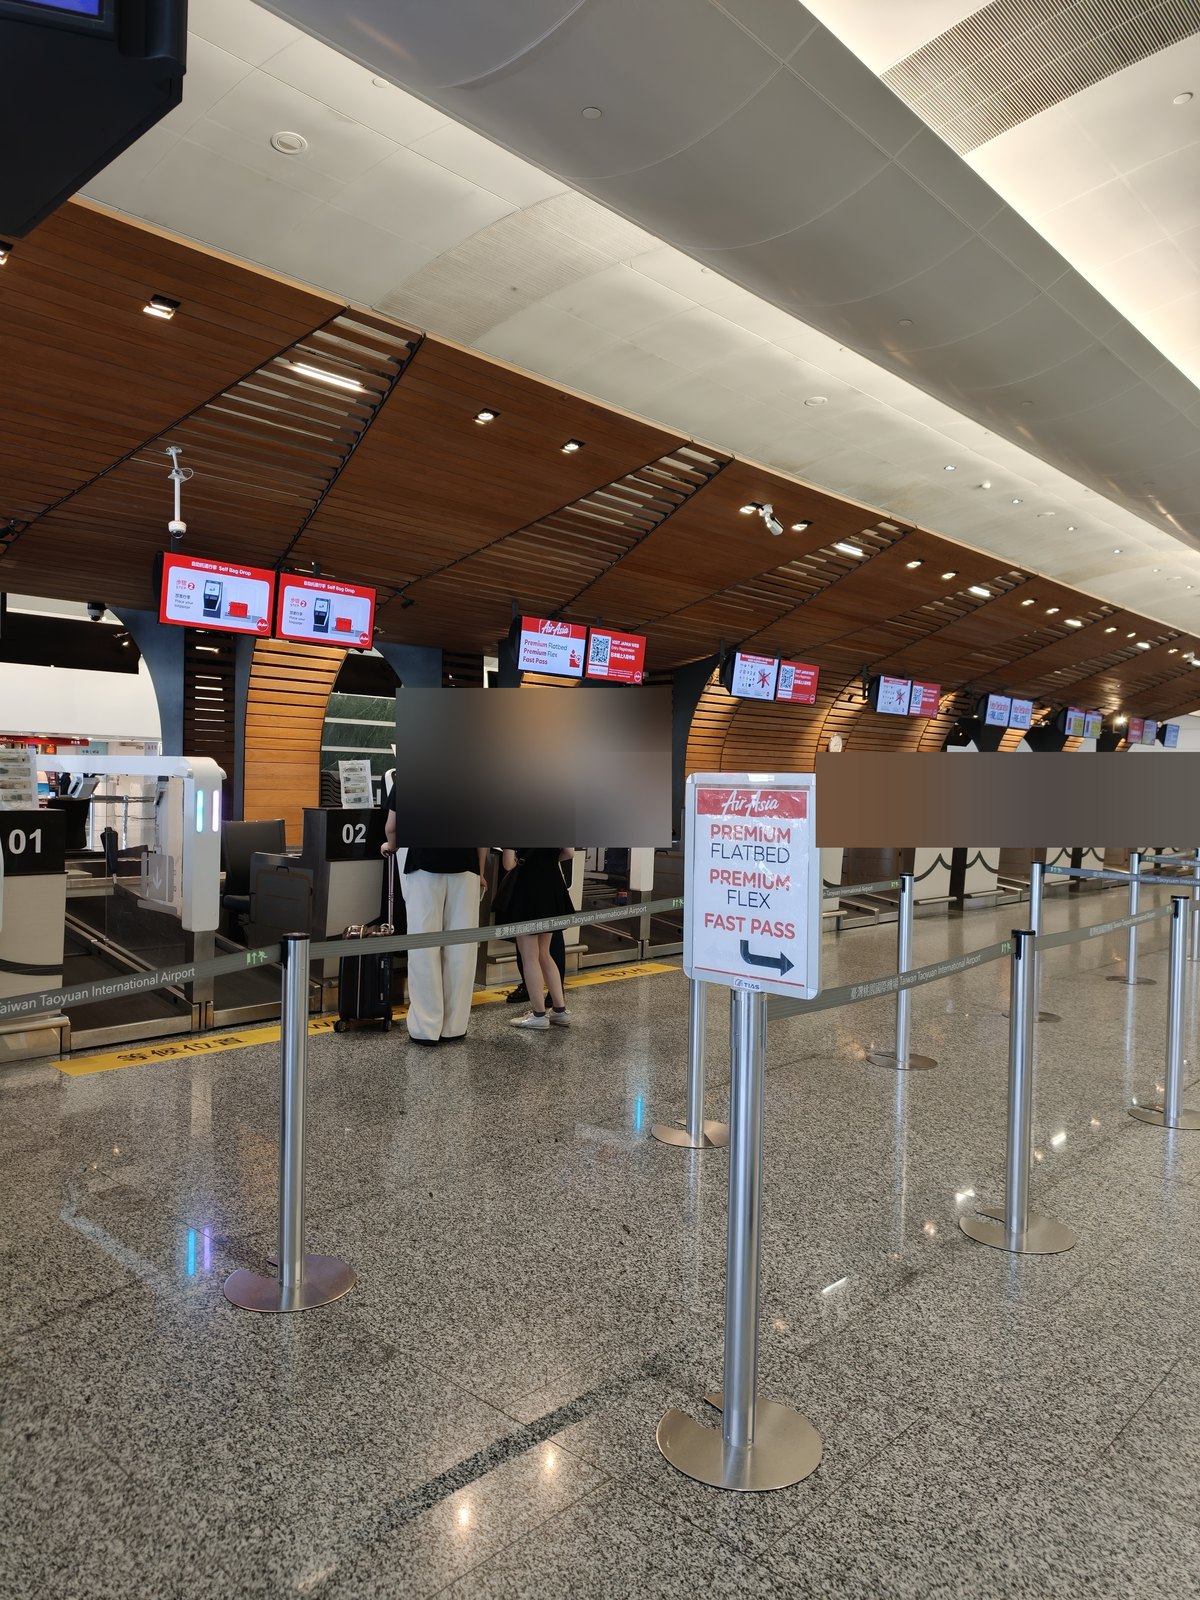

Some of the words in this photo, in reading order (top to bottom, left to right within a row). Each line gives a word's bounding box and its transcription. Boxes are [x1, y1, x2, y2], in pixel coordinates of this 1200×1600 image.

[523, 648, 546, 656] Premium
[547, 650, 558, 658] Flex
[524, 639, 547, 648] Premium
[548, 642, 568, 651] Flatbed
[522, 656, 535, 664] Fast
[535, 657, 548, 665] Pass
[9, 828, 42, 855] 01
[342, 823, 367, 844] 02
[711, 824, 791, 844] PREMIUM
[711, 843, 790, 864] FLATBED
[709, 868, 790, 891] PREMIUM
[727, 889, 771, 910] FLEX
[550, 918, 571, 928] Taiwan
[571, 914, 594, 925] Taoyuan
[595, 907, 629, 920] International
[629, 905, 648, 915] Airport
[704, 912, 746, 933] FAST
[750, 918, 796, 940] PASS
[899, 975, 917, 986] Taiwan
[917, 969, 938, 981] Taoyuan
[938, 958, 966, 975] International
[965, 954, 981, 967] Airport
[40, 989, 89, 1010] Taoyuan
[92, 975, 159, 998] International
[161, 967, 196, 984] Airport
